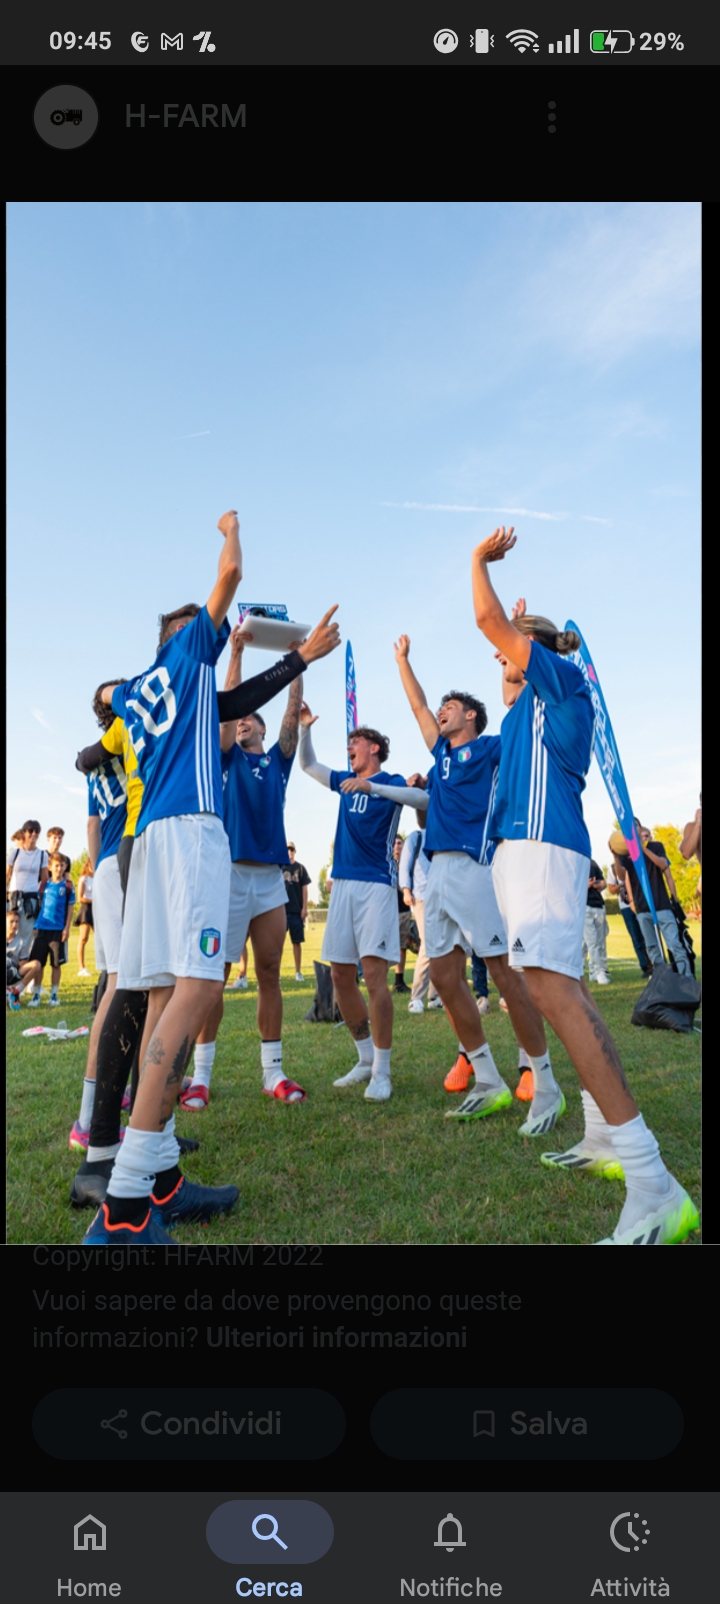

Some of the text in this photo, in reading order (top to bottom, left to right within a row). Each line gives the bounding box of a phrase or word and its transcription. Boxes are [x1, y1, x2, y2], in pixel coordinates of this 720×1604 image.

[49, 31, 112, 50] 09:45
[639, 32, 685, 51] 29%
[125, 103, 247, 128] H-FARM
[264, 665, 289, 681] KIPSTA
[442, 756, 451, 780] 9
[349, 793, 369, 813] 10
[32, 1245, 324, 1272] Copyright: HFARM 2022
[31, 1288, 522, 1317] Vuoi sapere da dove provengono queste
[33, 1325, 467, 1348] informazioni? Ulteriori informazioni
[140, 1410, 282, 1436] Condividi
[510, 1410, 588, 1436] Salva
[57, 1578, 122, 1597] Home
[235, 1578, 303, 1598] Cerca
[400, 1577, 503, 1597] Notifiche
[590, 1577, 670, 1597] Attività
